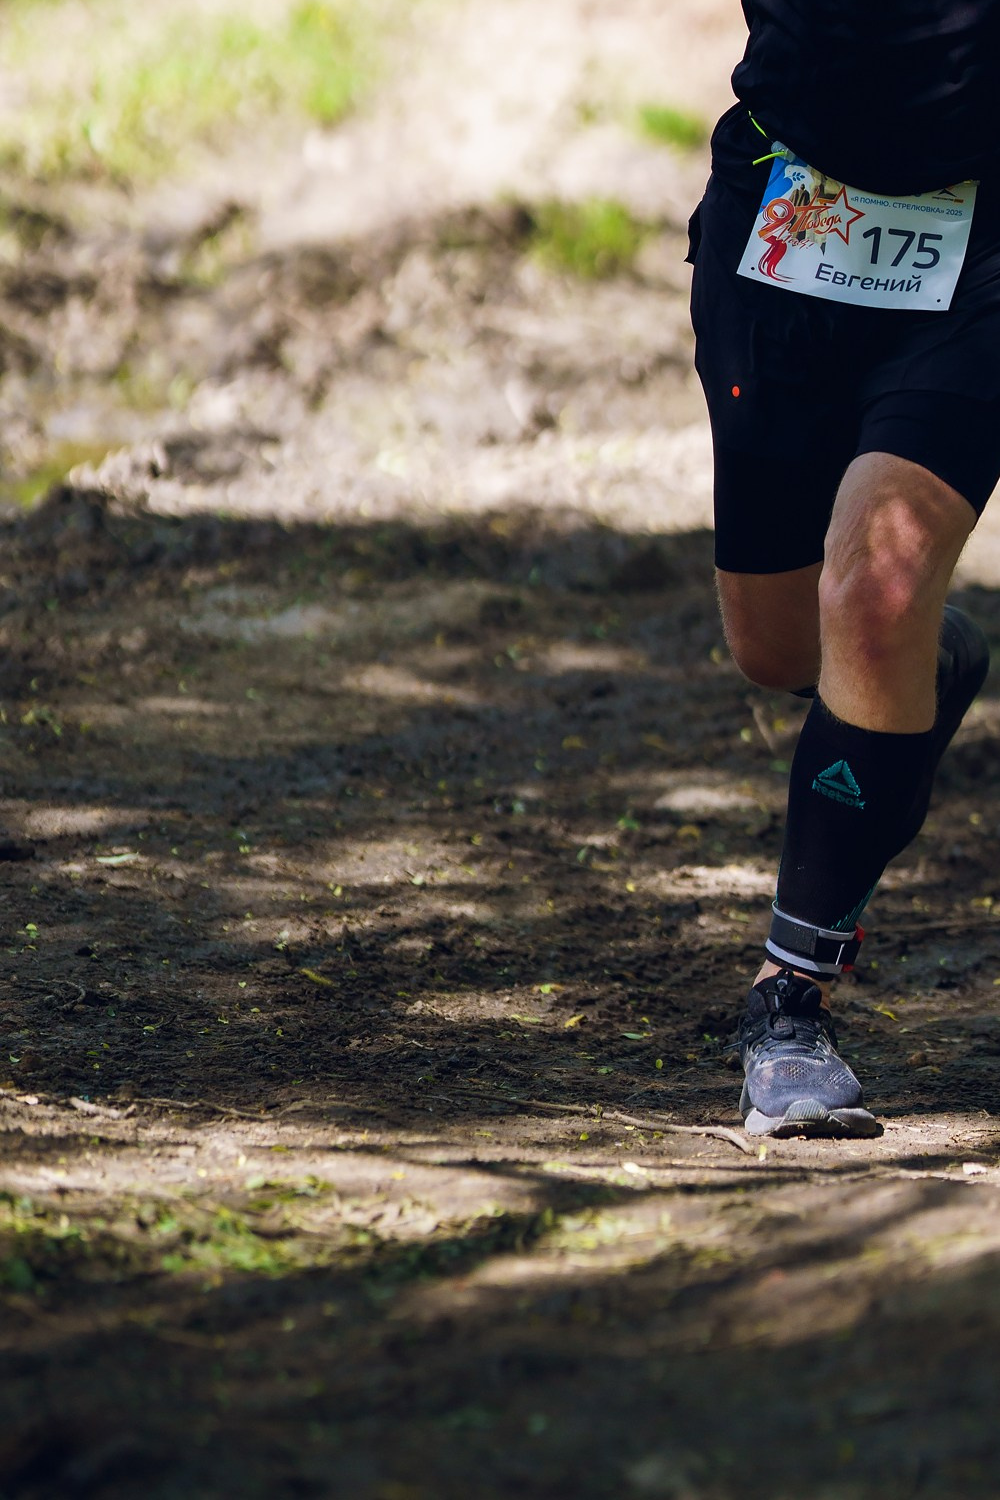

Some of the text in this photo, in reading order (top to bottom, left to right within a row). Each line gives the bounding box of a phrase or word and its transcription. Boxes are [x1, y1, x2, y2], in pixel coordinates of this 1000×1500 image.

[860, 197, 891, 207] ПОМНЮ.
[893, 202, 945, 214] СТРЕЛКОВКА»
[946, 209, 963, 217] 2025
[862, 226, 943, 270] 175
[814, 263, 922, 293] Евгений
[812, 779, 866, 810] Reebok
